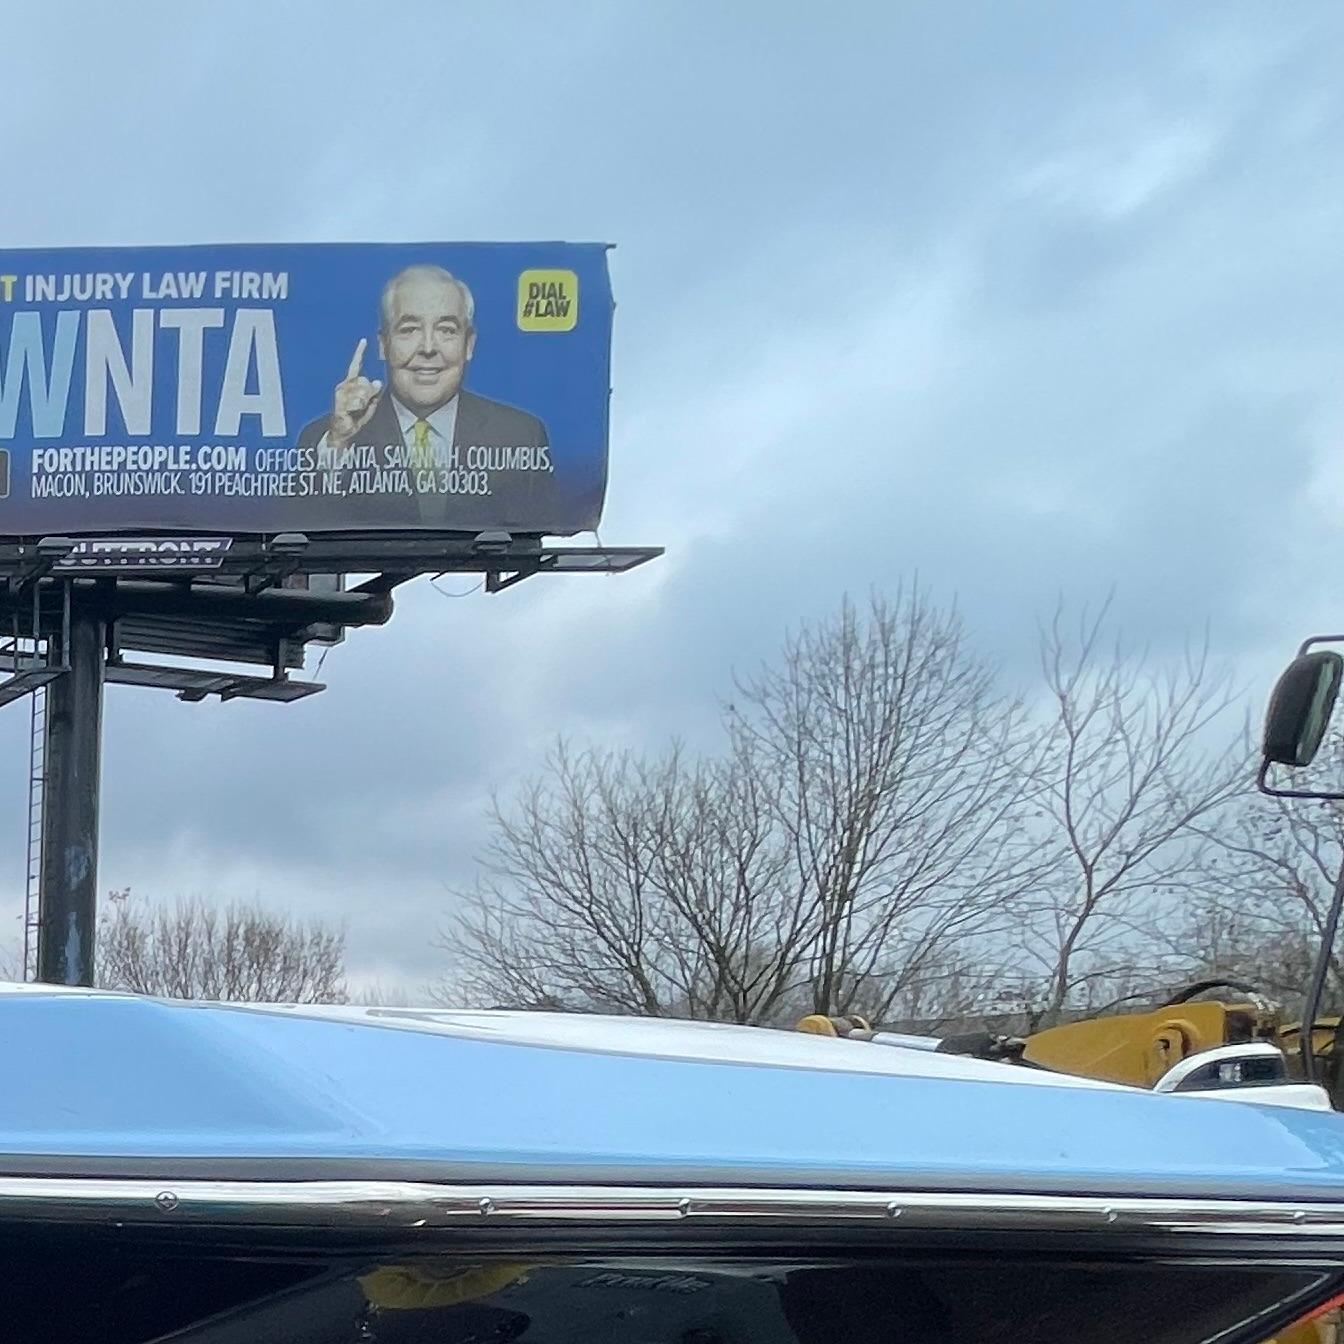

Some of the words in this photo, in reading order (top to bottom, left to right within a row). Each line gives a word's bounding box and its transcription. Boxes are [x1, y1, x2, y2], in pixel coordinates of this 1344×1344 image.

[25, 272, 135, 302] INJURY
[142, 271, 207, 299] LAW
[214, 270, 289, 299] FIRM
[529, 282, 567, 300] DIAL
[523, 299, 572, 318] #LAW
[31, 446, 247, 474] FORTHEPEOPLE.COM
[255, 449, 315, 472] OFFICES
[466, 445, 554, 473] COLUMBUS,
[31, 473, 90, 498] MACON,
[94, 471, 186, 496] BRUNSWICK.
[188, 472, 212, 495] 191
[215, 472, 296, 497] PEACHTREE
[298, 472, 319, 496] ST.
[322, 472, 347, 497] NE,
[349, 470, 413, 497] ATLANTA,
[416, 470, 436, 494] GA
[438, 469, 492, 496] 30303.
